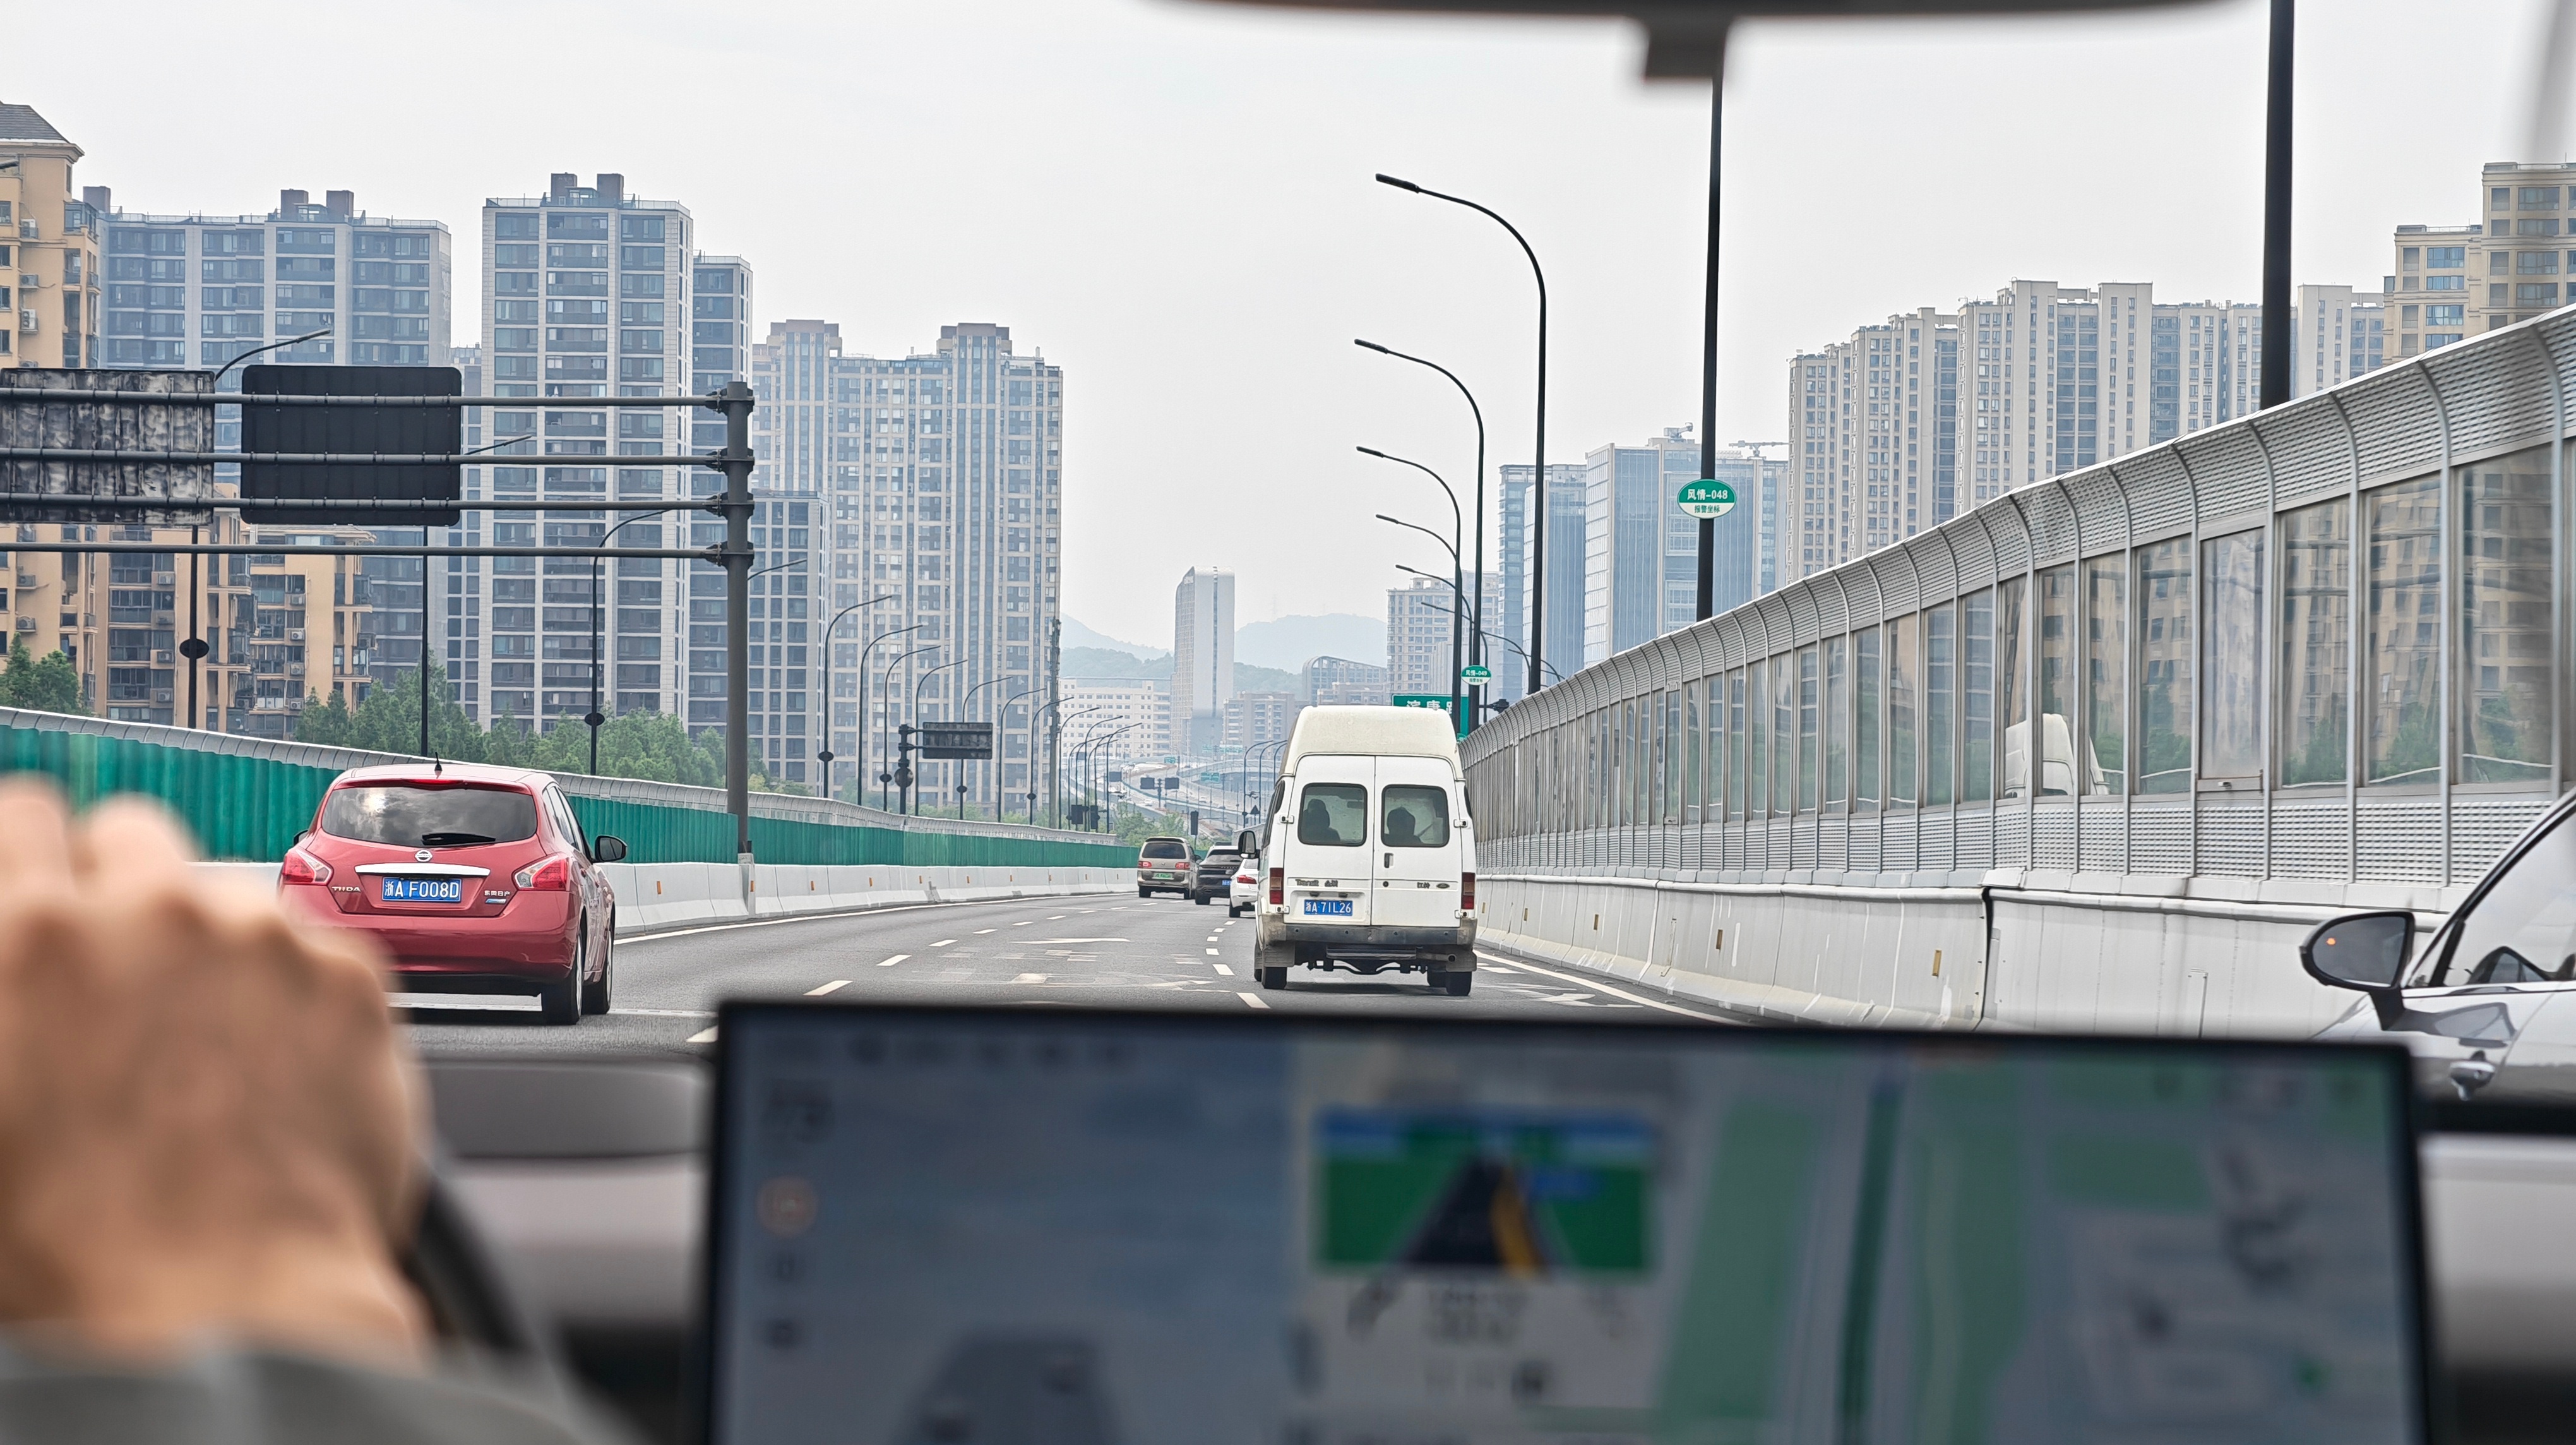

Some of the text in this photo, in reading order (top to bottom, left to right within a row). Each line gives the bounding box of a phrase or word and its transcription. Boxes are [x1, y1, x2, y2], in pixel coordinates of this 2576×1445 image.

[1687, 489, 1728, 501] 风情-048
[1694, 505, 1720, 513] 报警坐标
